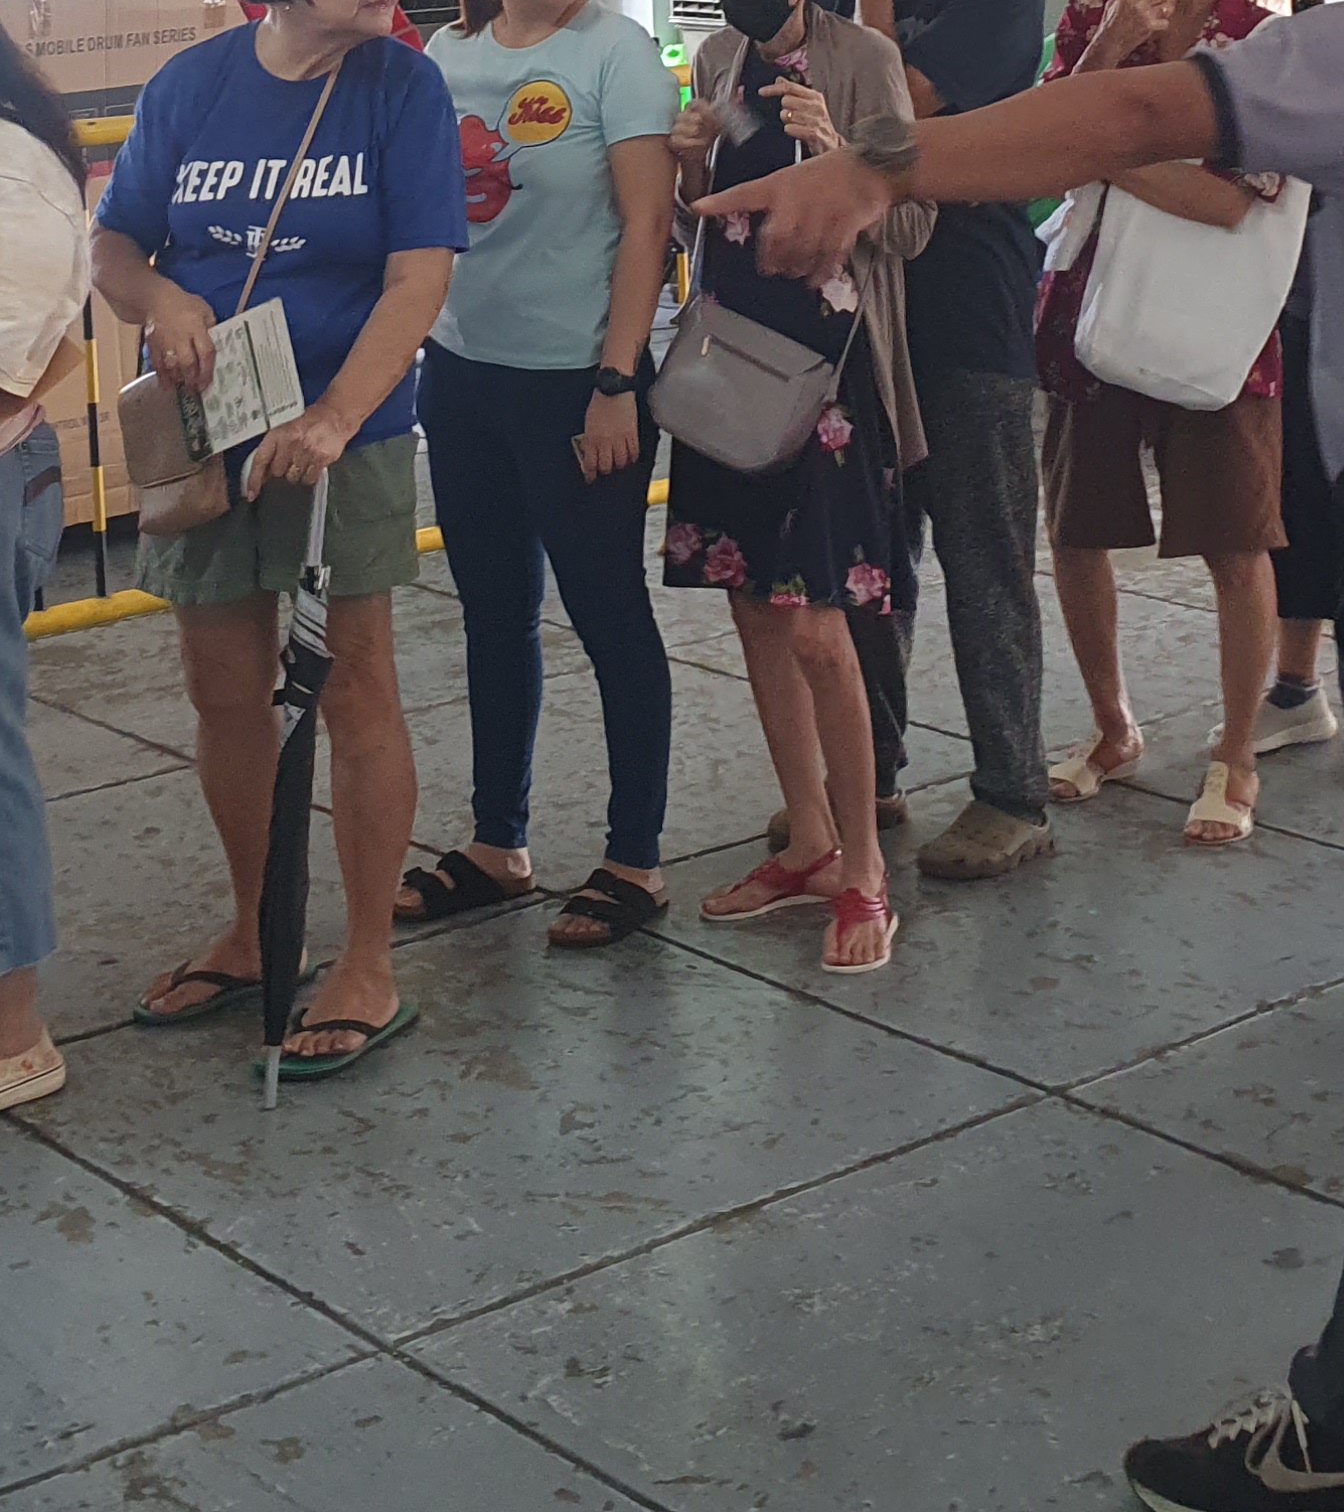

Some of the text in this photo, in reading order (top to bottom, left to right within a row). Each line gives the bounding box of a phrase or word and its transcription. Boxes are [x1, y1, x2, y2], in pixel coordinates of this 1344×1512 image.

[35, 39, 85, 57] MOBILE
[87, 33, 124, 52] DRUM
[125, 30, 151, 48] FAN
[153, 27, 197, 45] SERIES
[171, 152, 368, 204] KEEP IT REAL
